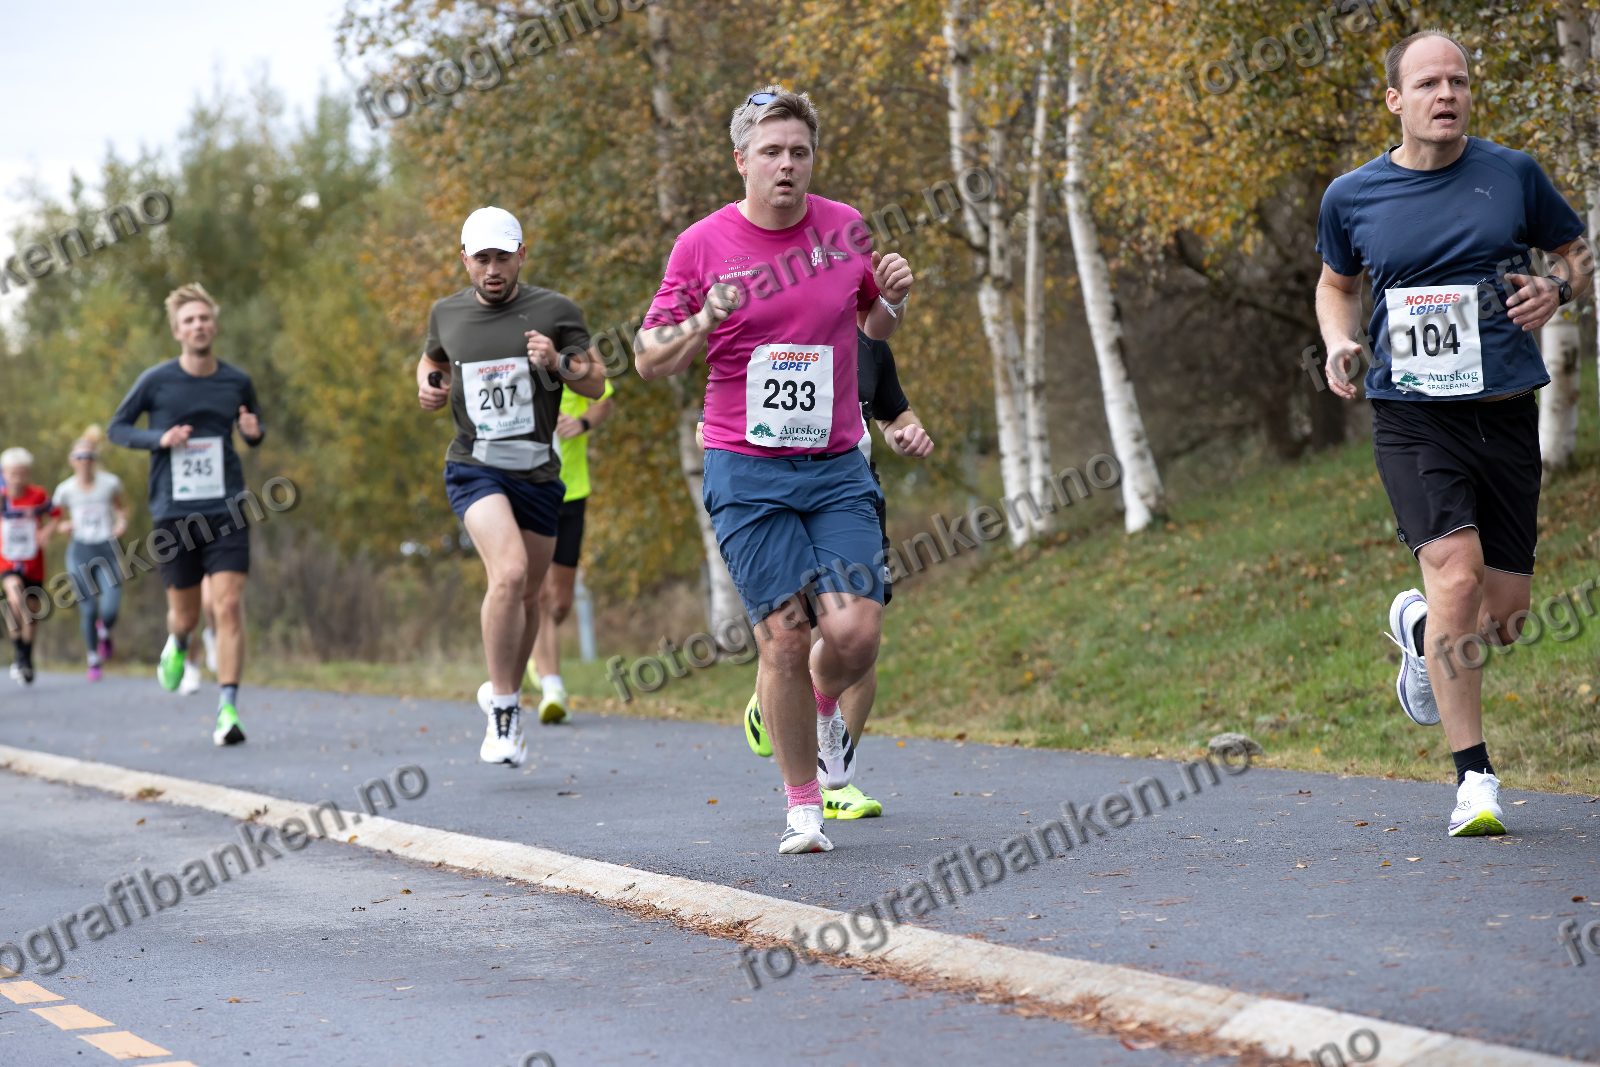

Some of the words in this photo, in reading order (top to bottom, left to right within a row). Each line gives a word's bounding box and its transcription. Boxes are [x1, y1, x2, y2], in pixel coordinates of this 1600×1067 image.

[1405, 294, 1461, 305] NORGES
[1410, 304, 1452, 315] LØPET
[1406, 323, 1461, 357] 104
[768, 351, 820, 362] NORGES
[772, 361, 811, 371] LØPET
[1428, 370, 1479, 383] Aurskog
[479, 385, 517, 410] 207
[763, 378, 816, 411] 233
[780, 425, 828, 439] Aurskog
[182, 458, 213, 477] 245
